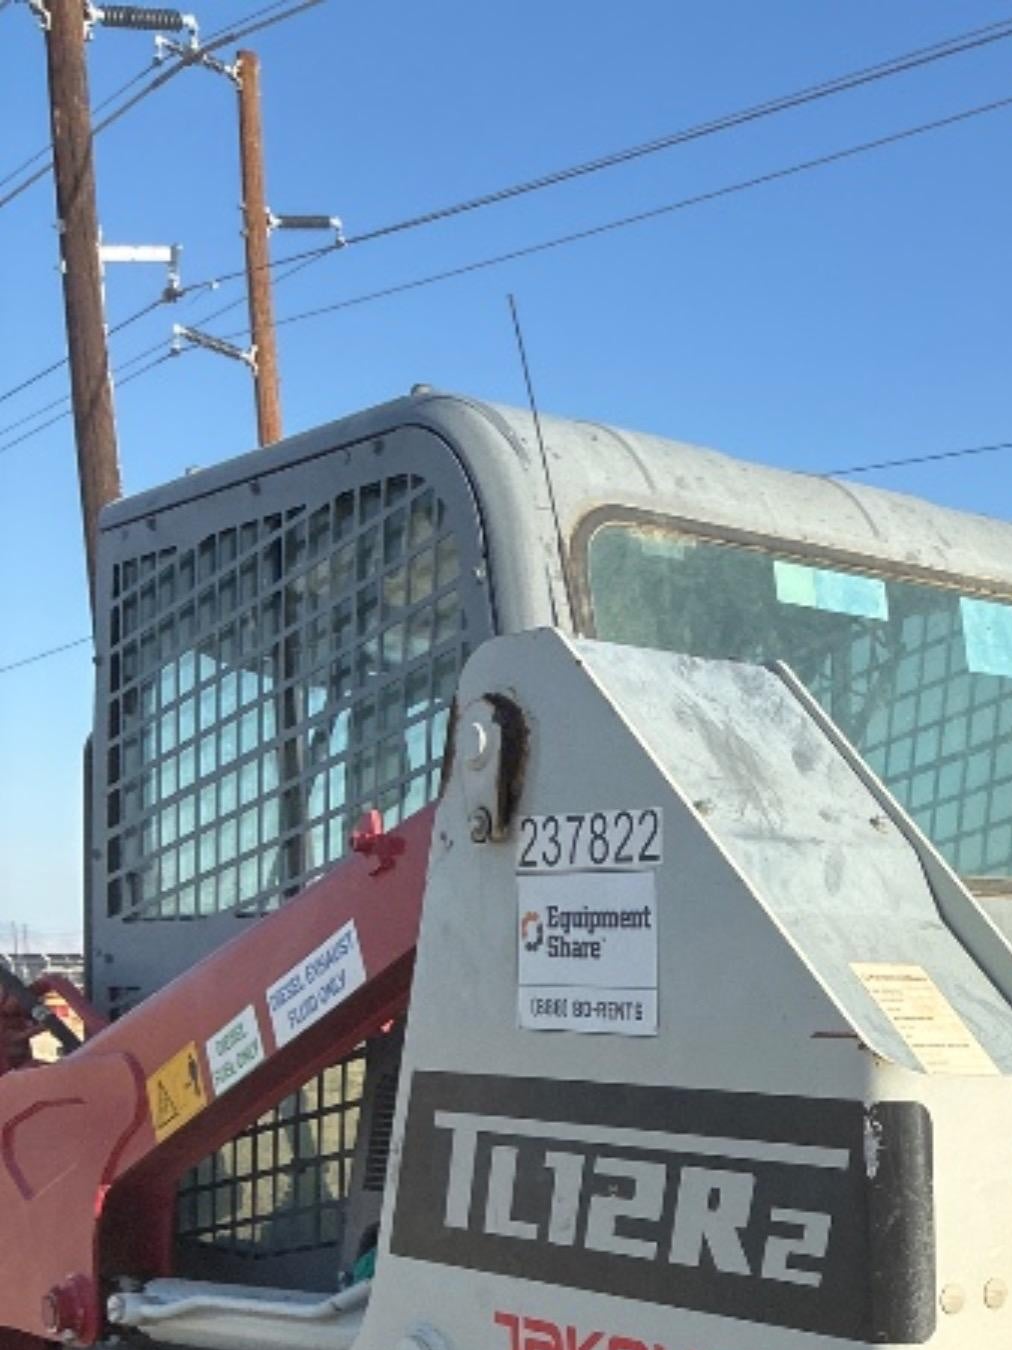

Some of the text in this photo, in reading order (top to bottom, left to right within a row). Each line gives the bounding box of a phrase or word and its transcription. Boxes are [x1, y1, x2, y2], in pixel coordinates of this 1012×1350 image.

[518, 809, 661, 868] 237822
[546, 905, 652, 934] Equipment
[547, 935, 601, 960] Share
[434, 1110, 850, 1288] TL12R2
